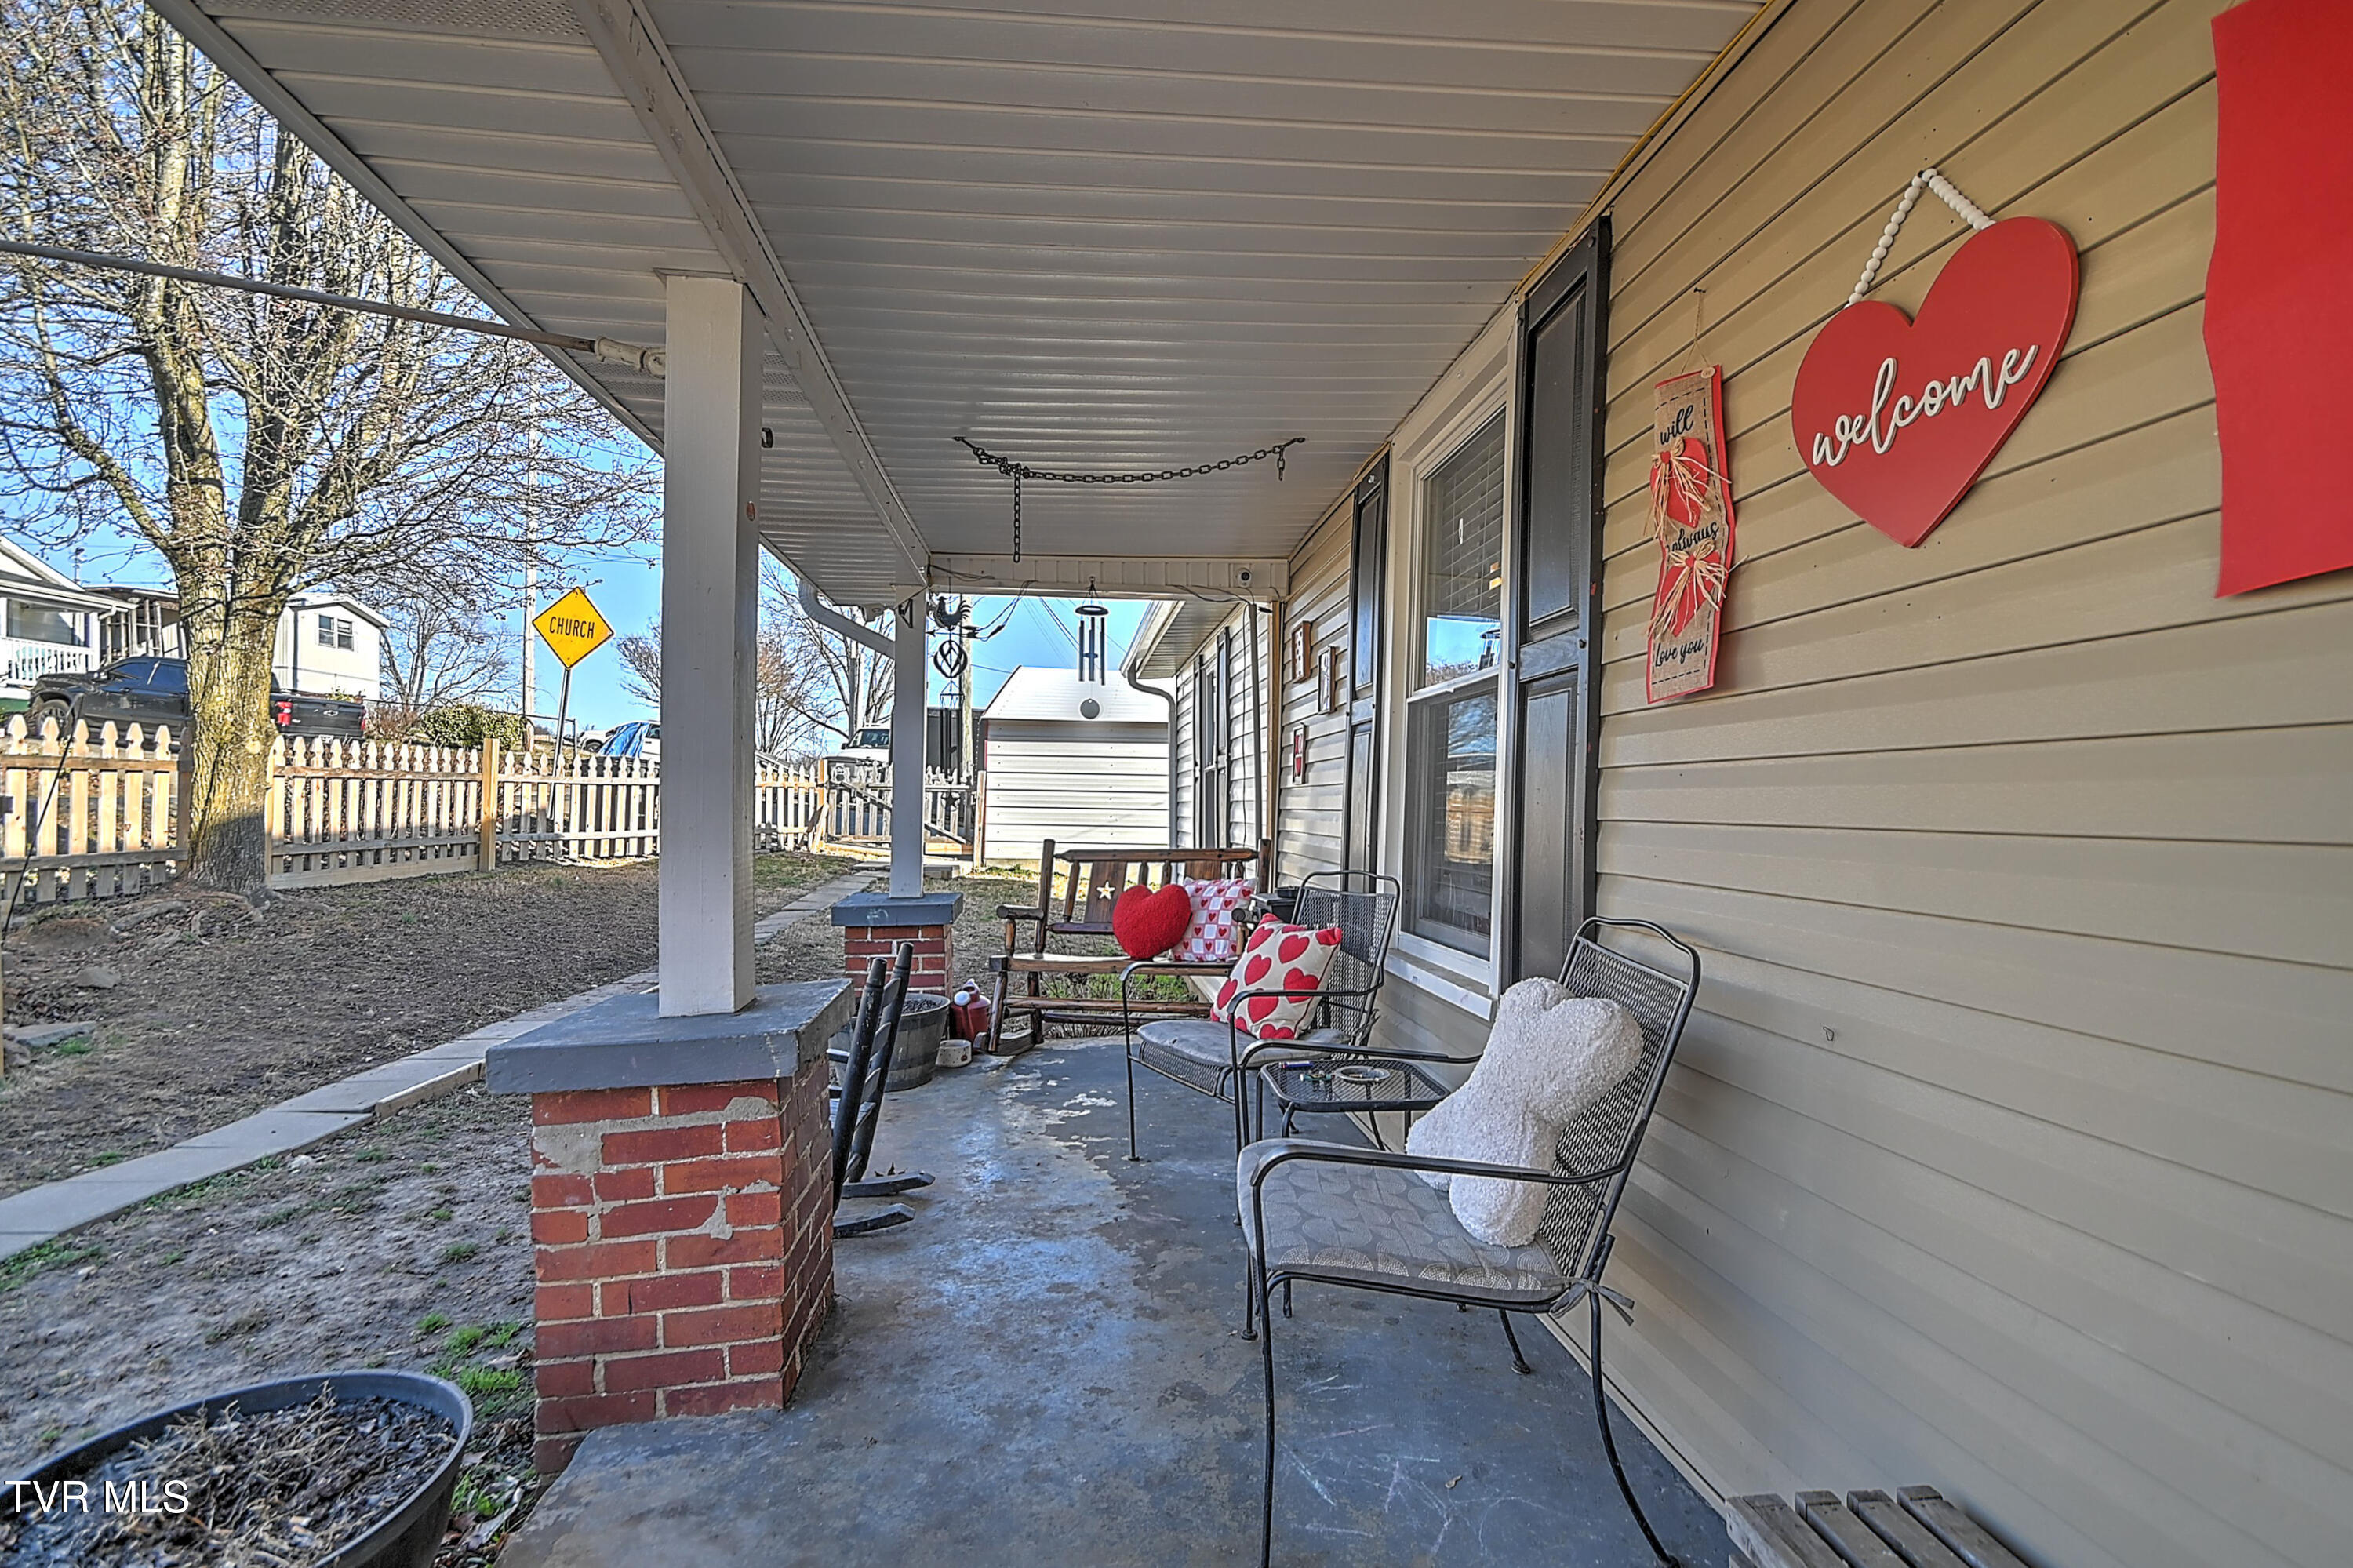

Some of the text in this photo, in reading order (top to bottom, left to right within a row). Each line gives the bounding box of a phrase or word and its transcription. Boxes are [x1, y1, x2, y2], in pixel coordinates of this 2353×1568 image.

[1813, 344, 2039, 467] welcome
[1660, 404, 1694, 446] will
[549, 616, 595, 639] CHURCH
[1680, 638, 1704, 664] you
